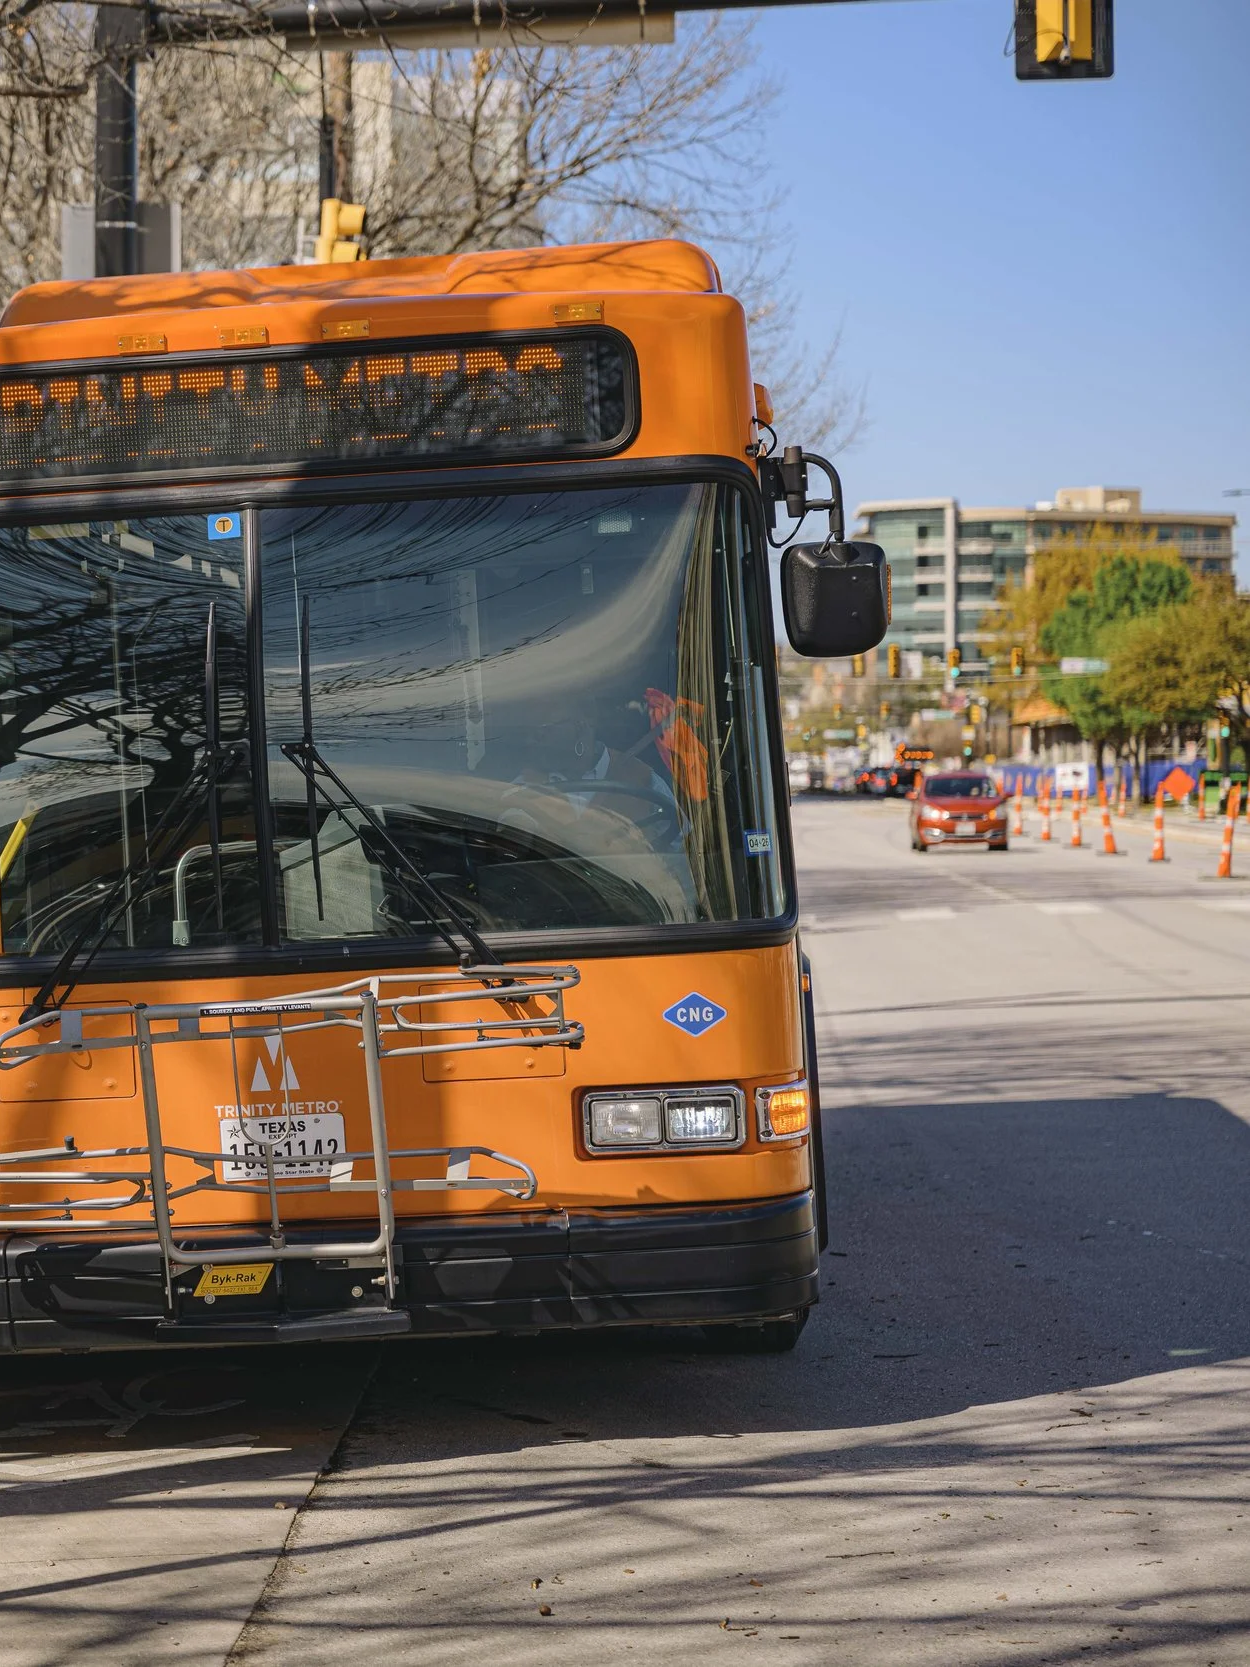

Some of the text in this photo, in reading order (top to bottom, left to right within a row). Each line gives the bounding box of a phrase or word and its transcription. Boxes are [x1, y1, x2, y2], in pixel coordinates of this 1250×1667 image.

[676, 1006, 714, 1022] CNG
[214, 1102, 277, 1118] TRINITY
[259, 1120, 306, 1134] TEXAS
[211, 1273, 256, 1285] Byk-Rak
